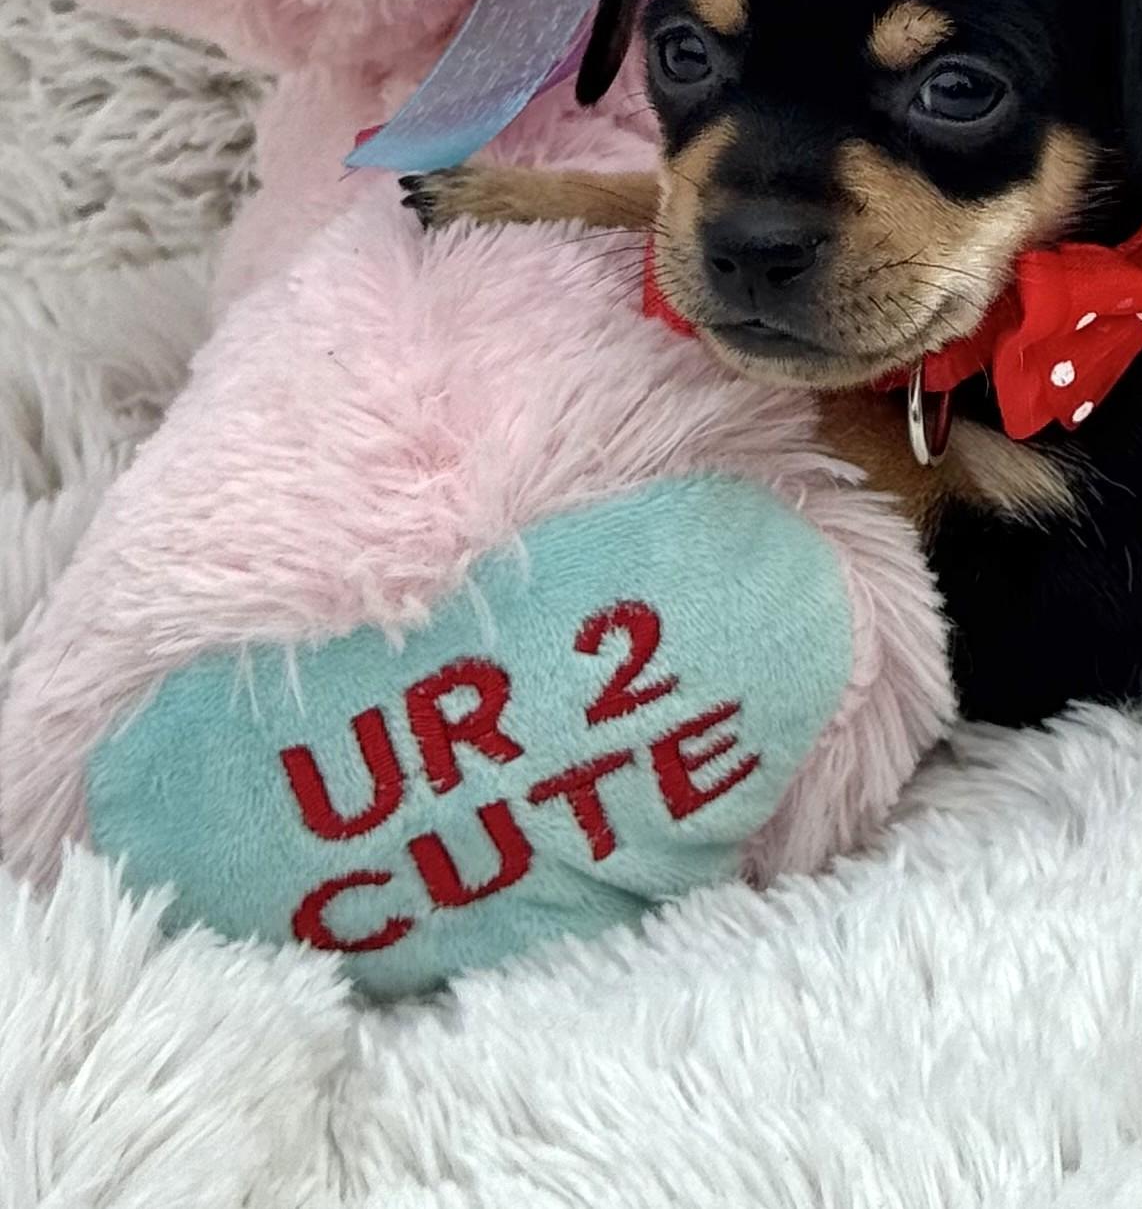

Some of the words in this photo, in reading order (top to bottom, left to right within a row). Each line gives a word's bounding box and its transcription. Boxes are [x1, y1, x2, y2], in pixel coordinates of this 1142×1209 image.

[279, 656, 526, 842] UR
[573, 599, 680, 727] 2
[291, 699, 765, 953] CUTE
